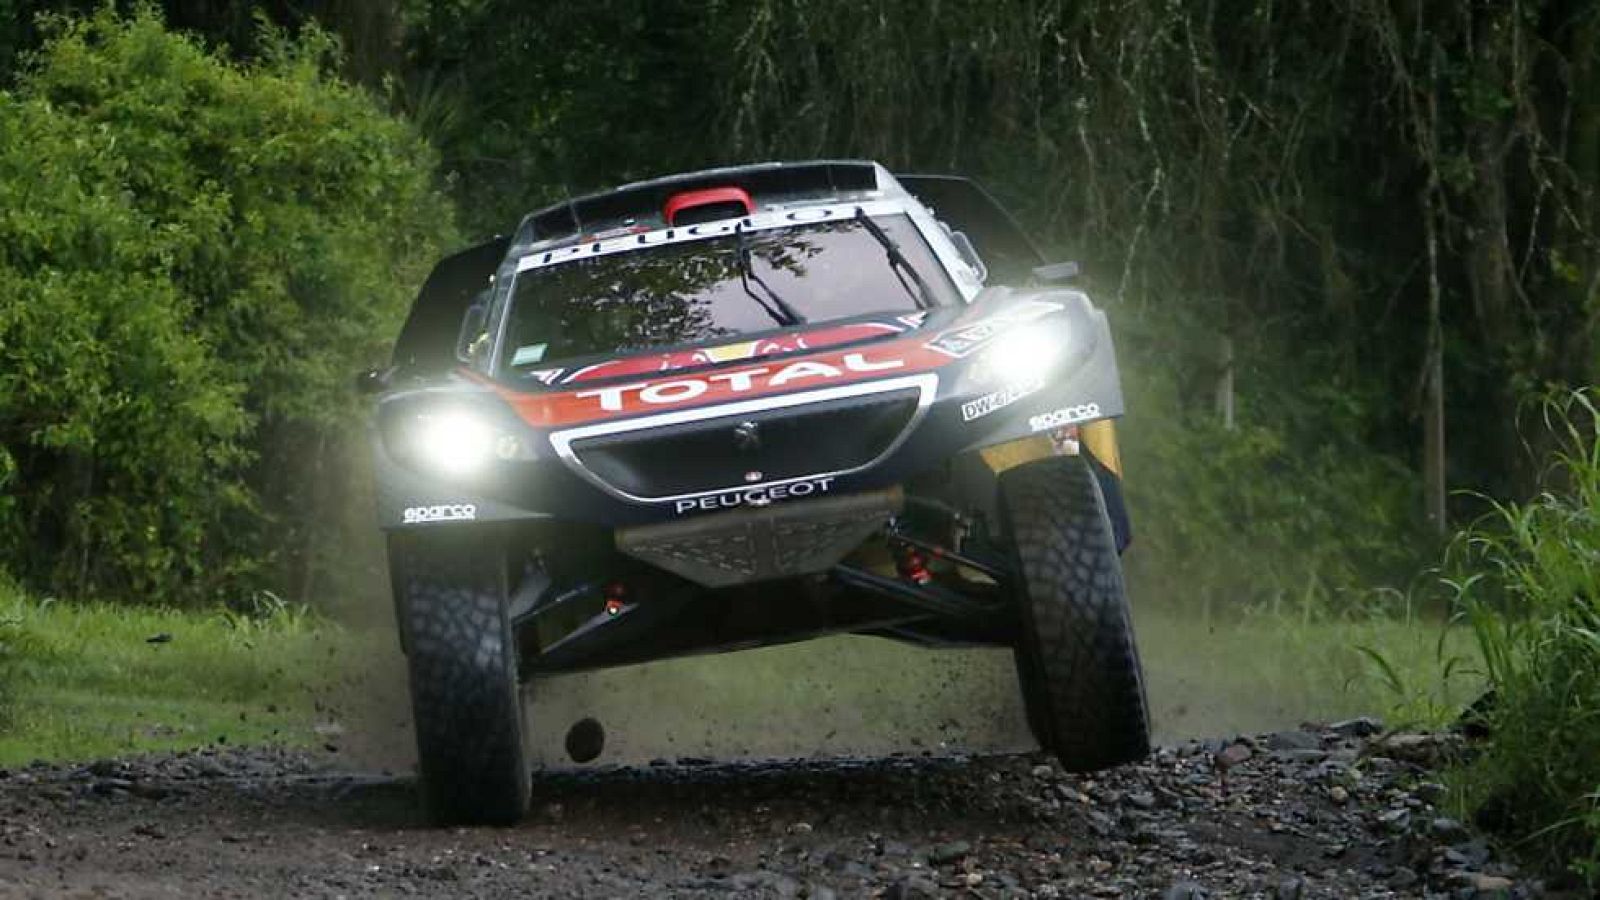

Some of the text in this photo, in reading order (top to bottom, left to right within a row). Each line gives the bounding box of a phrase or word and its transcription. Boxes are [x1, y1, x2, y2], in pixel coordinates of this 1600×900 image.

[576, 353, 904, 411] TOTAL
[1029, 402, 1101, 432] sparco
[676, 477, 835, 514] PEUGEOT
[403, 504, 476, 524] sparco
